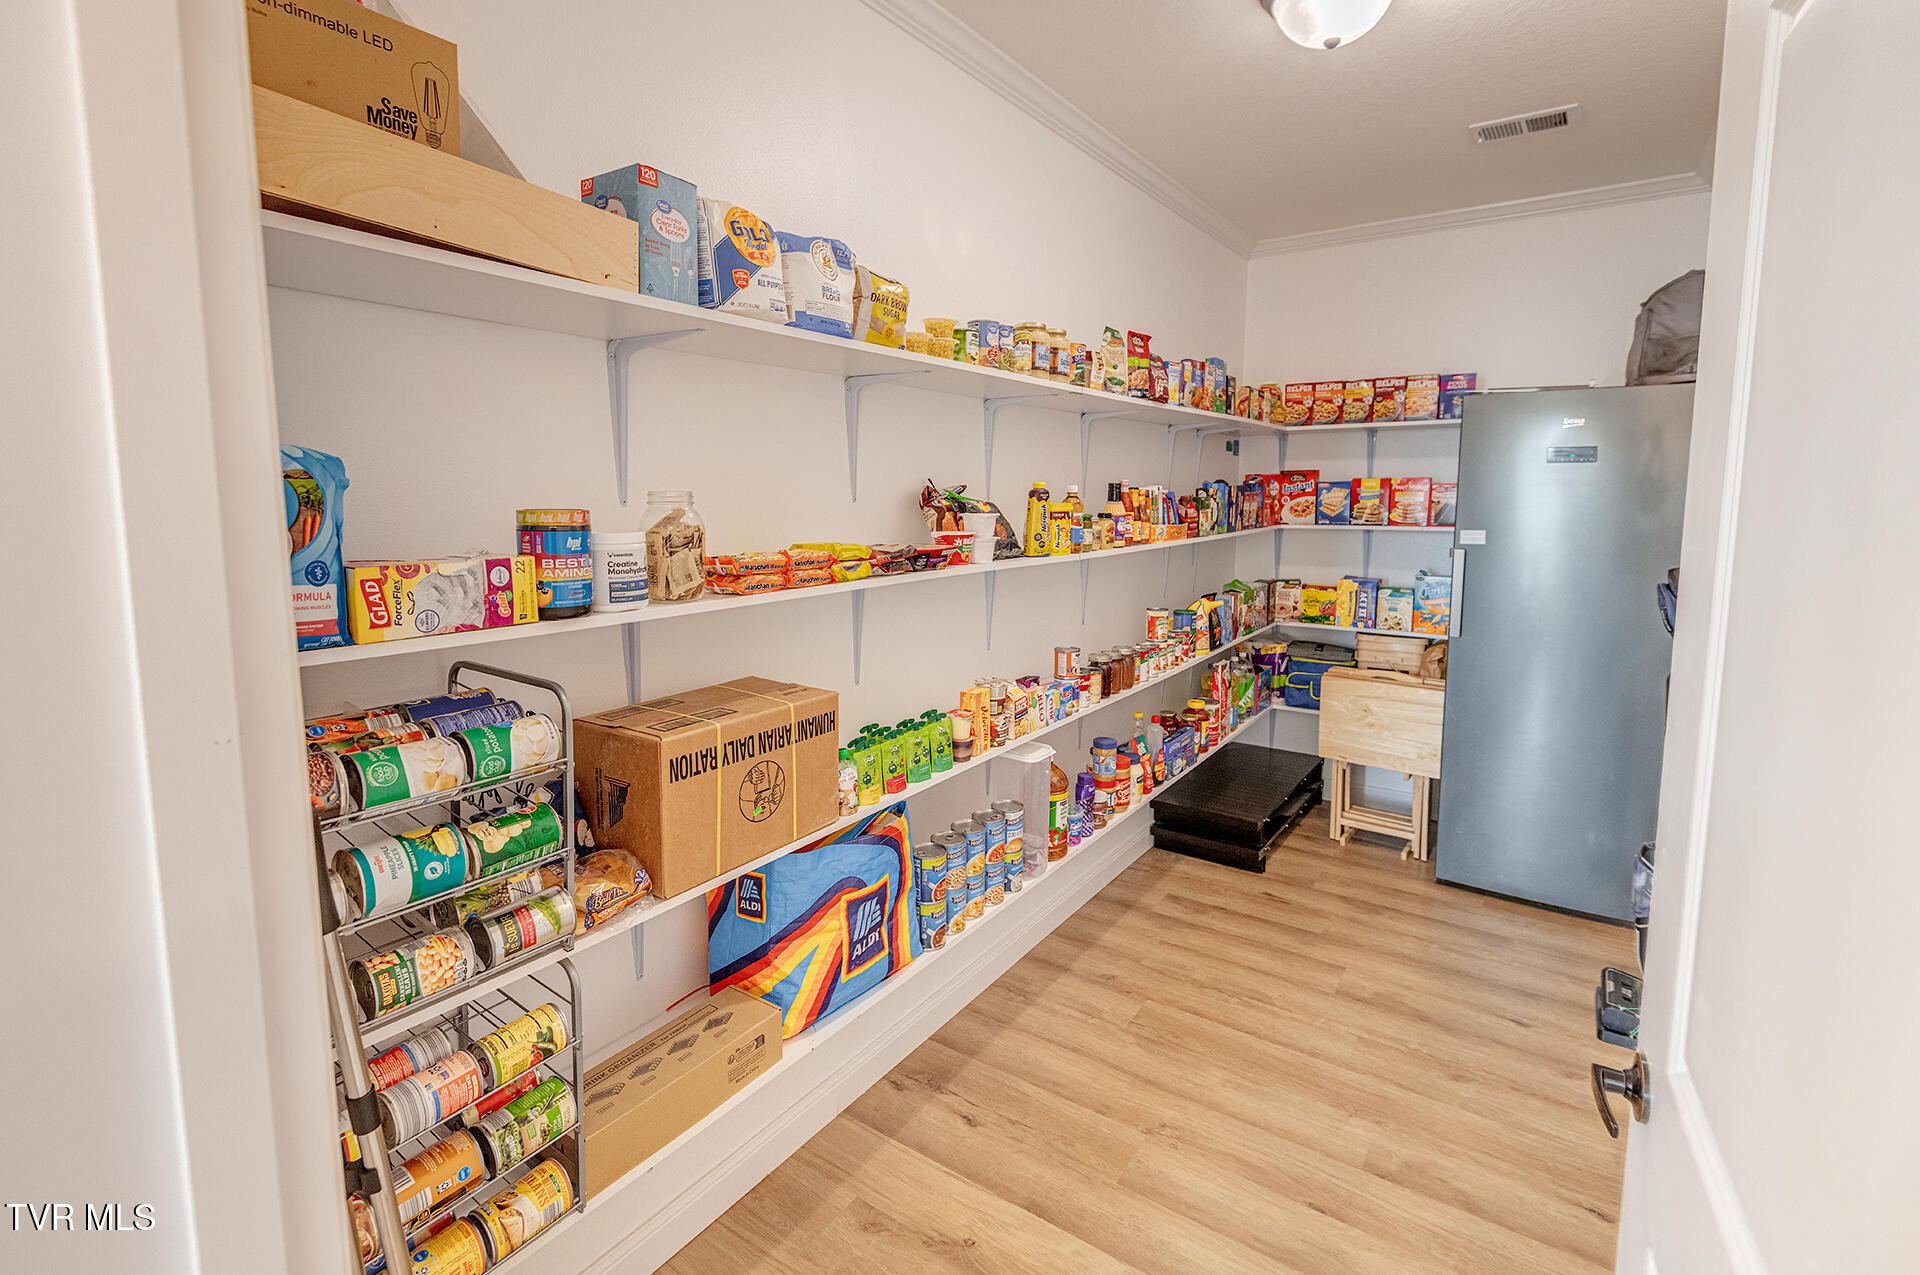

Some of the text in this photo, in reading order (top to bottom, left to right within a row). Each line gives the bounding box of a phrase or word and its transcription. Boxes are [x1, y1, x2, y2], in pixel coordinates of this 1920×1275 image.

[363, 30, 393, 51] LED
[367, 105, 418, 140] Money
[381, 97, 418, 124] Save
[640, 167, 656, 181] 120
[870, 292, 889, 306] DARK
[883, 306, 900, 320] SUGAR
[1282, 480, 1315, 493] Instant
[515, 560, 526, 573] 22
[541, 558, 585, 568] BEST
[607, 560, 639, 568] Creatine
[365, 580, 389, 625] GLAD
[392, 579, 403, 627] ForceFlex
[497, 591, 511, 617] Gain
[980, 705, 988, 742] Velveeta
[722, 735, 754, 767] DAILY
[669, 746, 718, 784] RATION
[374, 855, 385, 874] meijer
[380, 845, 398, 880] PINEAPPLE
[391, 848, 404, 870] SLICES
[740, 899, 761, 911] ALDI
[501, 914, 518, 943] SUEUR
[852, 927, 881, 960] ALDI
[401, 968, 412, 995] BEANS
[608, 1042, 656, 1073] ORGANIZER
[521, 1174, 545, 1208] BEANS
